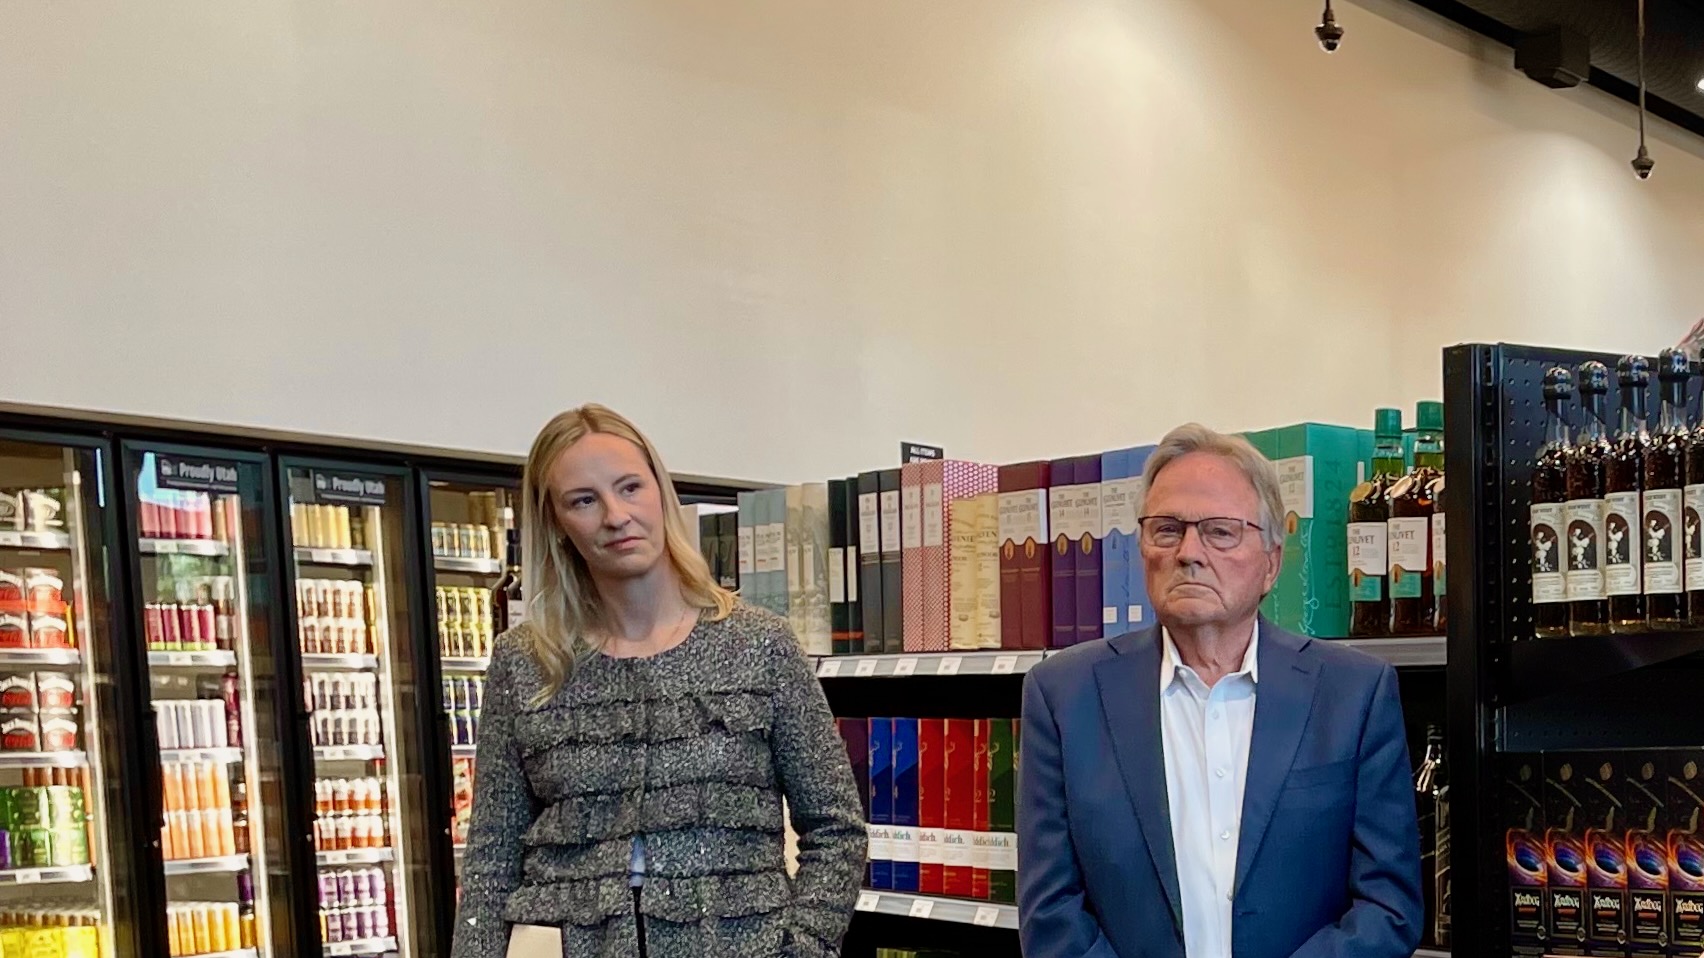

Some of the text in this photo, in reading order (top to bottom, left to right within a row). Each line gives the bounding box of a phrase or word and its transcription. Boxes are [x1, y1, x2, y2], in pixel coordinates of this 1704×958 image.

[179, 463, 237, 482] Proudly Utah
[332, 477, 385, 496] Proudly Utah
